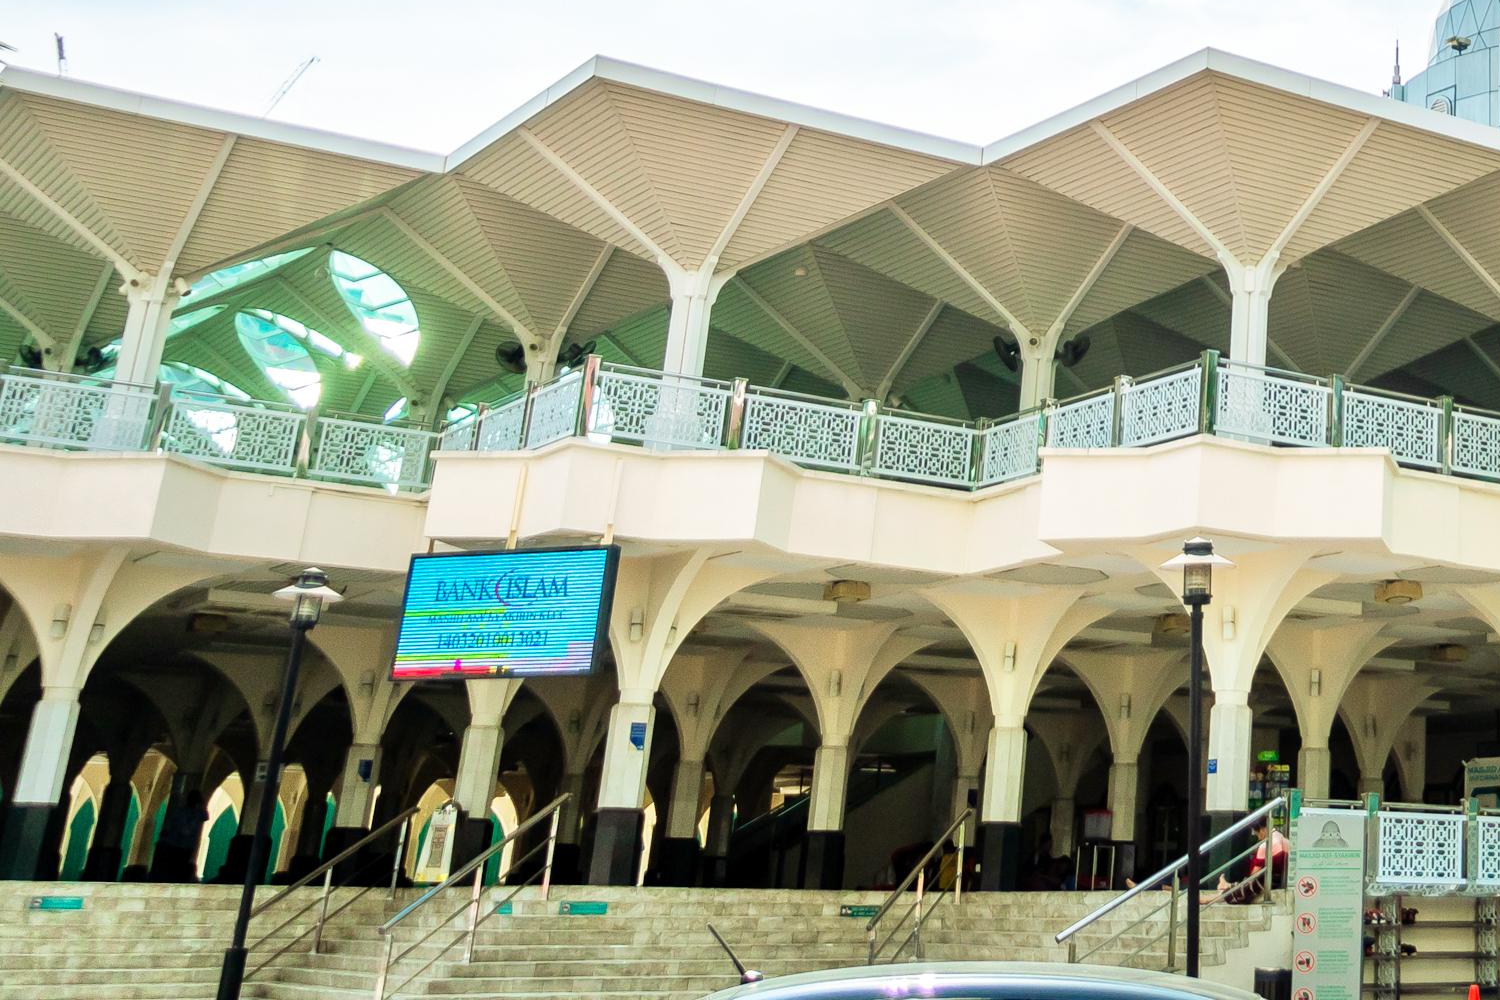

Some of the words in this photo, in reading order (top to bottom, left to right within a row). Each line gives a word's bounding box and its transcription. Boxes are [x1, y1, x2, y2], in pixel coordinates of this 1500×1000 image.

[435, 578, 497, 601] BANK
[505, 575, 569, 599] ISLAM
[1468, 765, 1497, 773] MASJID
